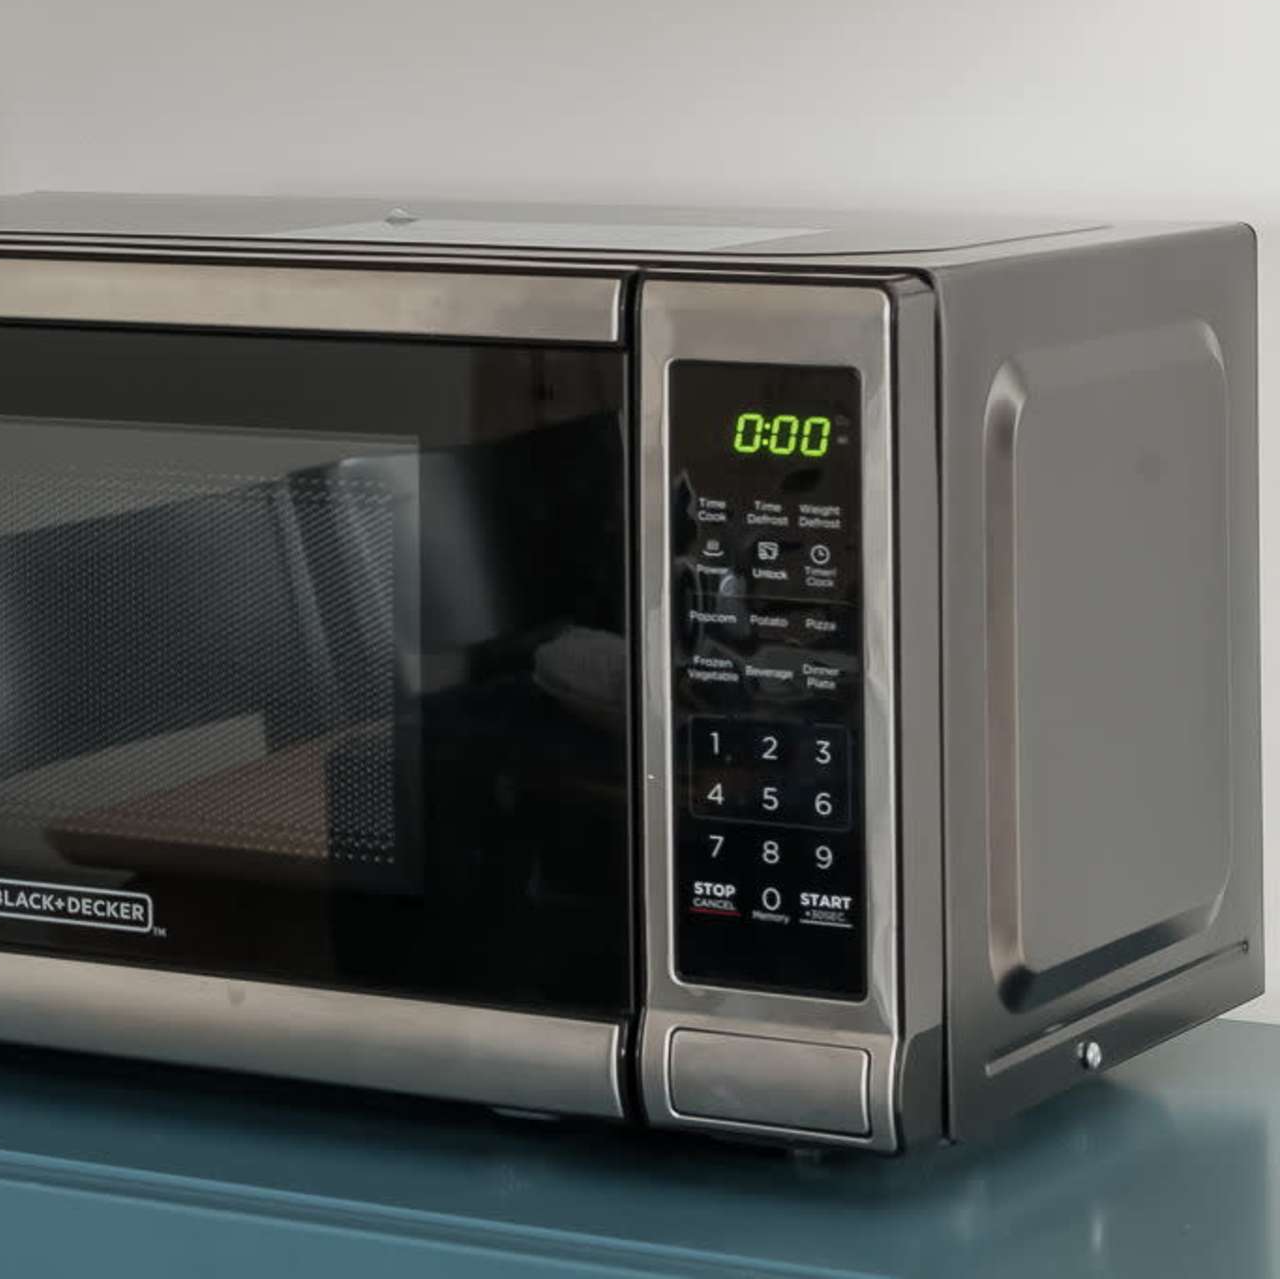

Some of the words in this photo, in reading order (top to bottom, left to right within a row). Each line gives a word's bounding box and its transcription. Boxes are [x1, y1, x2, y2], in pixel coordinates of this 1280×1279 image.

[734, 413, 830, 457] 0:00
[710, 732, 720, 755] 1
[761, 736, 779, 760] 2
[815, 740, 832, 764] 3
[706, 783, 725, 805] 4
[761, 787, 779, 811] 5
[814, 792, 832, 815] 6
[709, 835, 725, 858] 7
[762, 840, 780, 864] 8
[815, 845, 833, 869] 9
[693, 881, 736, 898] STOP
[761, 887, 781, 911] 0
[800, 892, 853, 910] START
[692, 897, 736, 910] CANCEL
